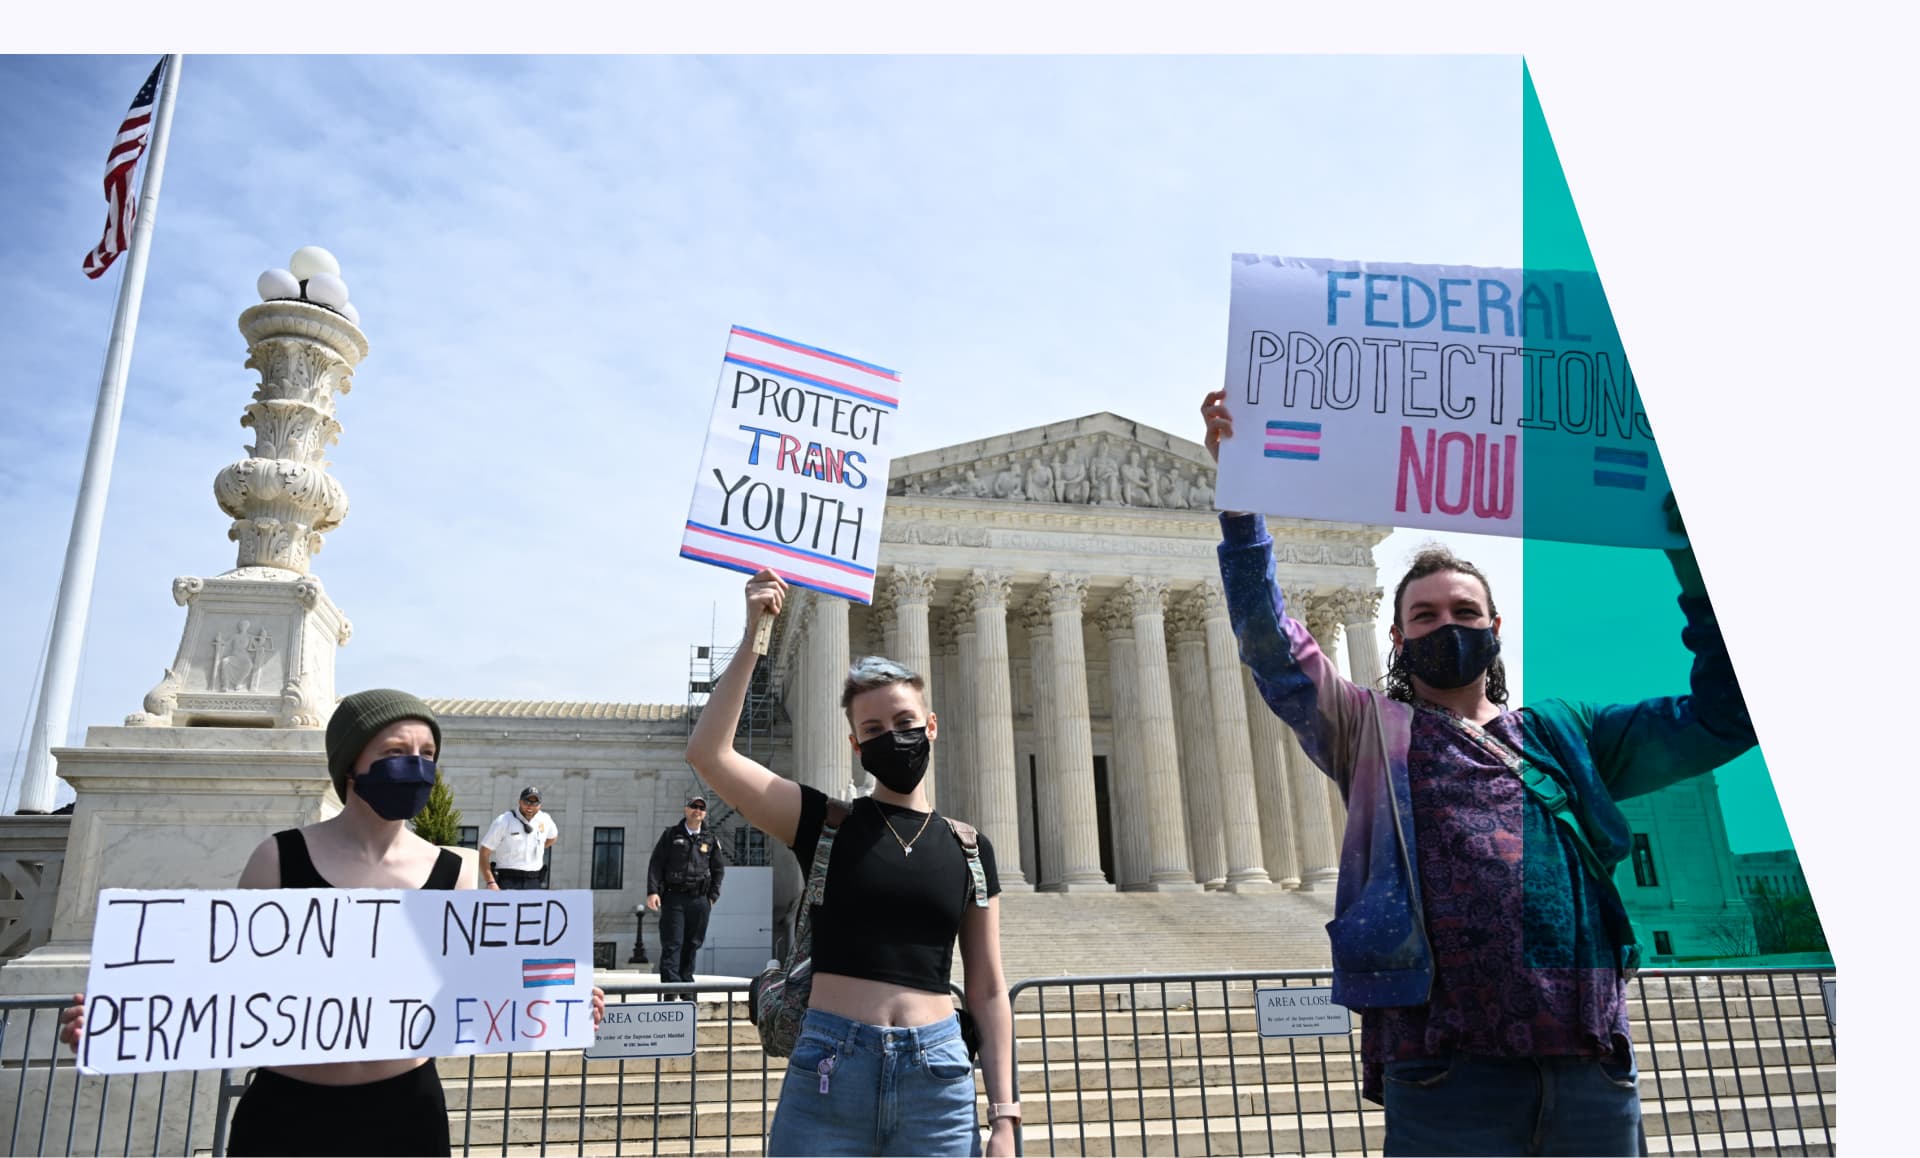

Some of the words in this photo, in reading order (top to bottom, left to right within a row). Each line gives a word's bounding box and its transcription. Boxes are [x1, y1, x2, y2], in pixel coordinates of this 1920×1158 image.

[1327, 270, 1592, 343] FEDERAL
[731, 370, 889, 445] PROTECT
[739, 424, 868, 489] TRANS
[1395, 425, 1517, 520] NOW
[712, 468, 863, 560] YOUTH
[105, 898, 185, 968] I
[209, 897, 400, 963] DON'T
[443, 900, 568, 956] NEED
[83, 992, 372, 1067] PERMISSION
[389, 999, 436, 1050] TO
[455, 998, 584, 1045] EXIST
[638, 1011, 684, 1023] CLOSED
[1268, 997, 1296, 1007] AREA
[1300, 995, 1330, 1006] CLOSE
